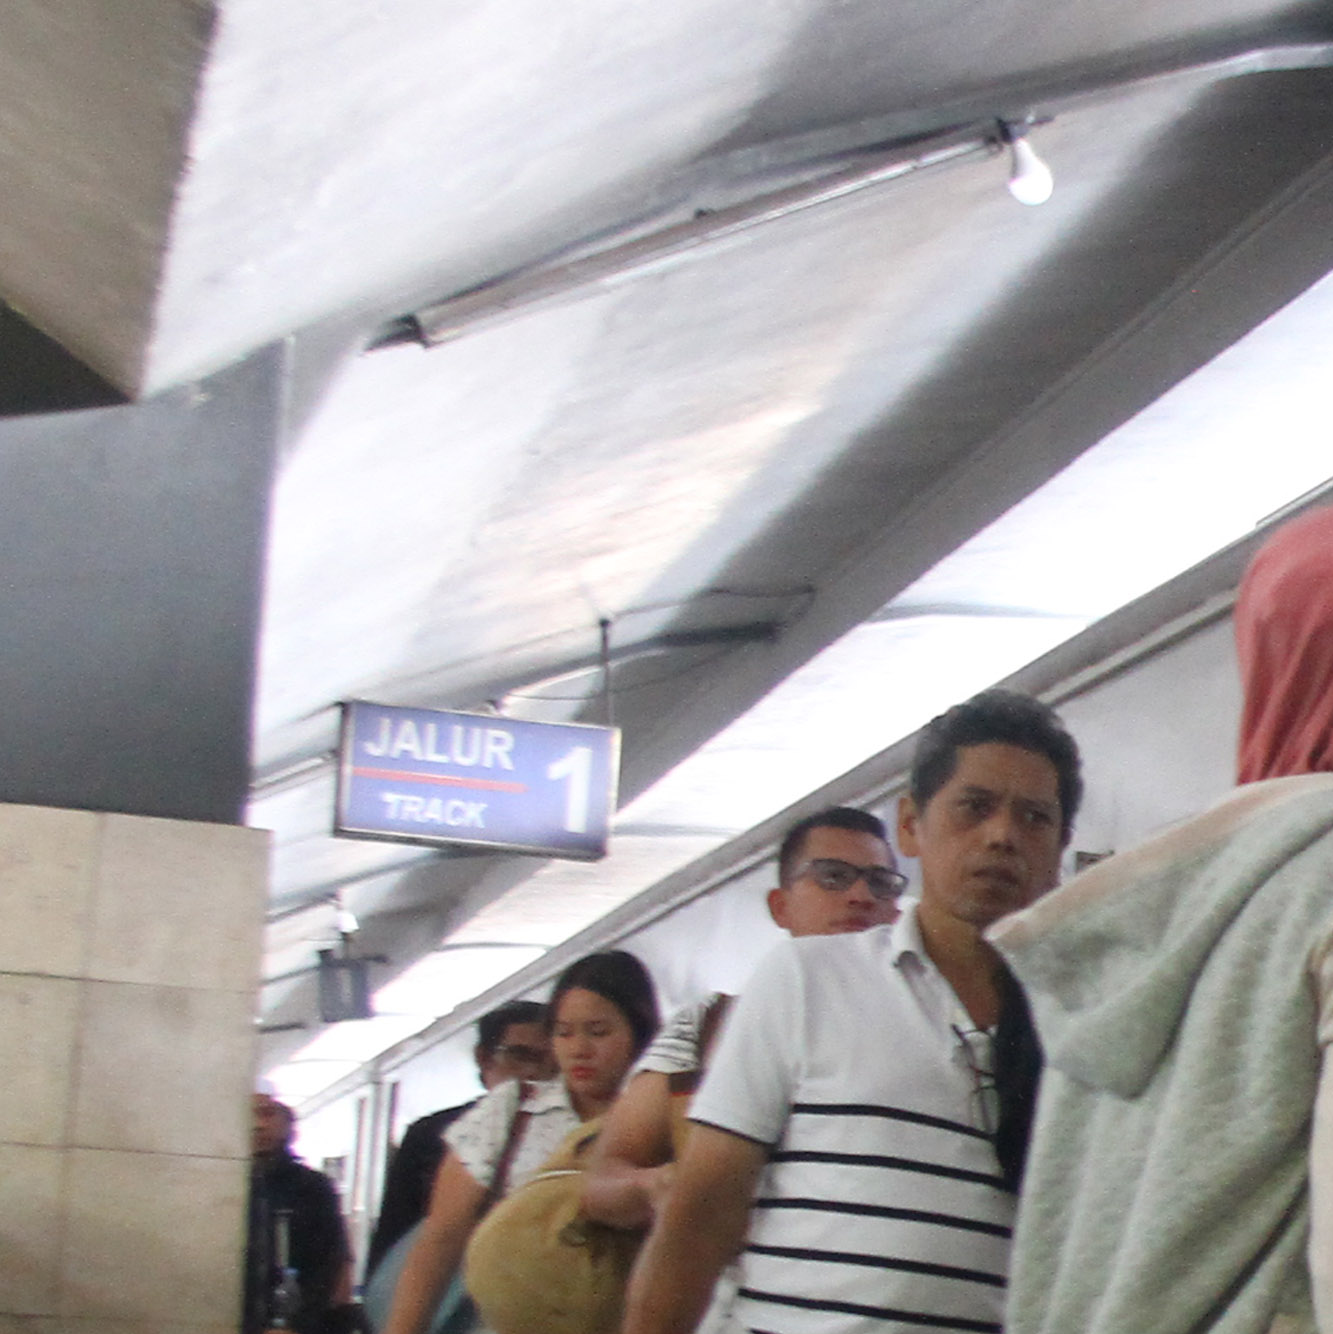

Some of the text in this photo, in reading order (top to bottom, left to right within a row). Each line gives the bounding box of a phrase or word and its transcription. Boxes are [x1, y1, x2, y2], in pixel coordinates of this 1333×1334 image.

[362, 716, 515, 771] JALUR
[381, 791, 489, 830] TRACK
[546, 744, 595, 834] 1
